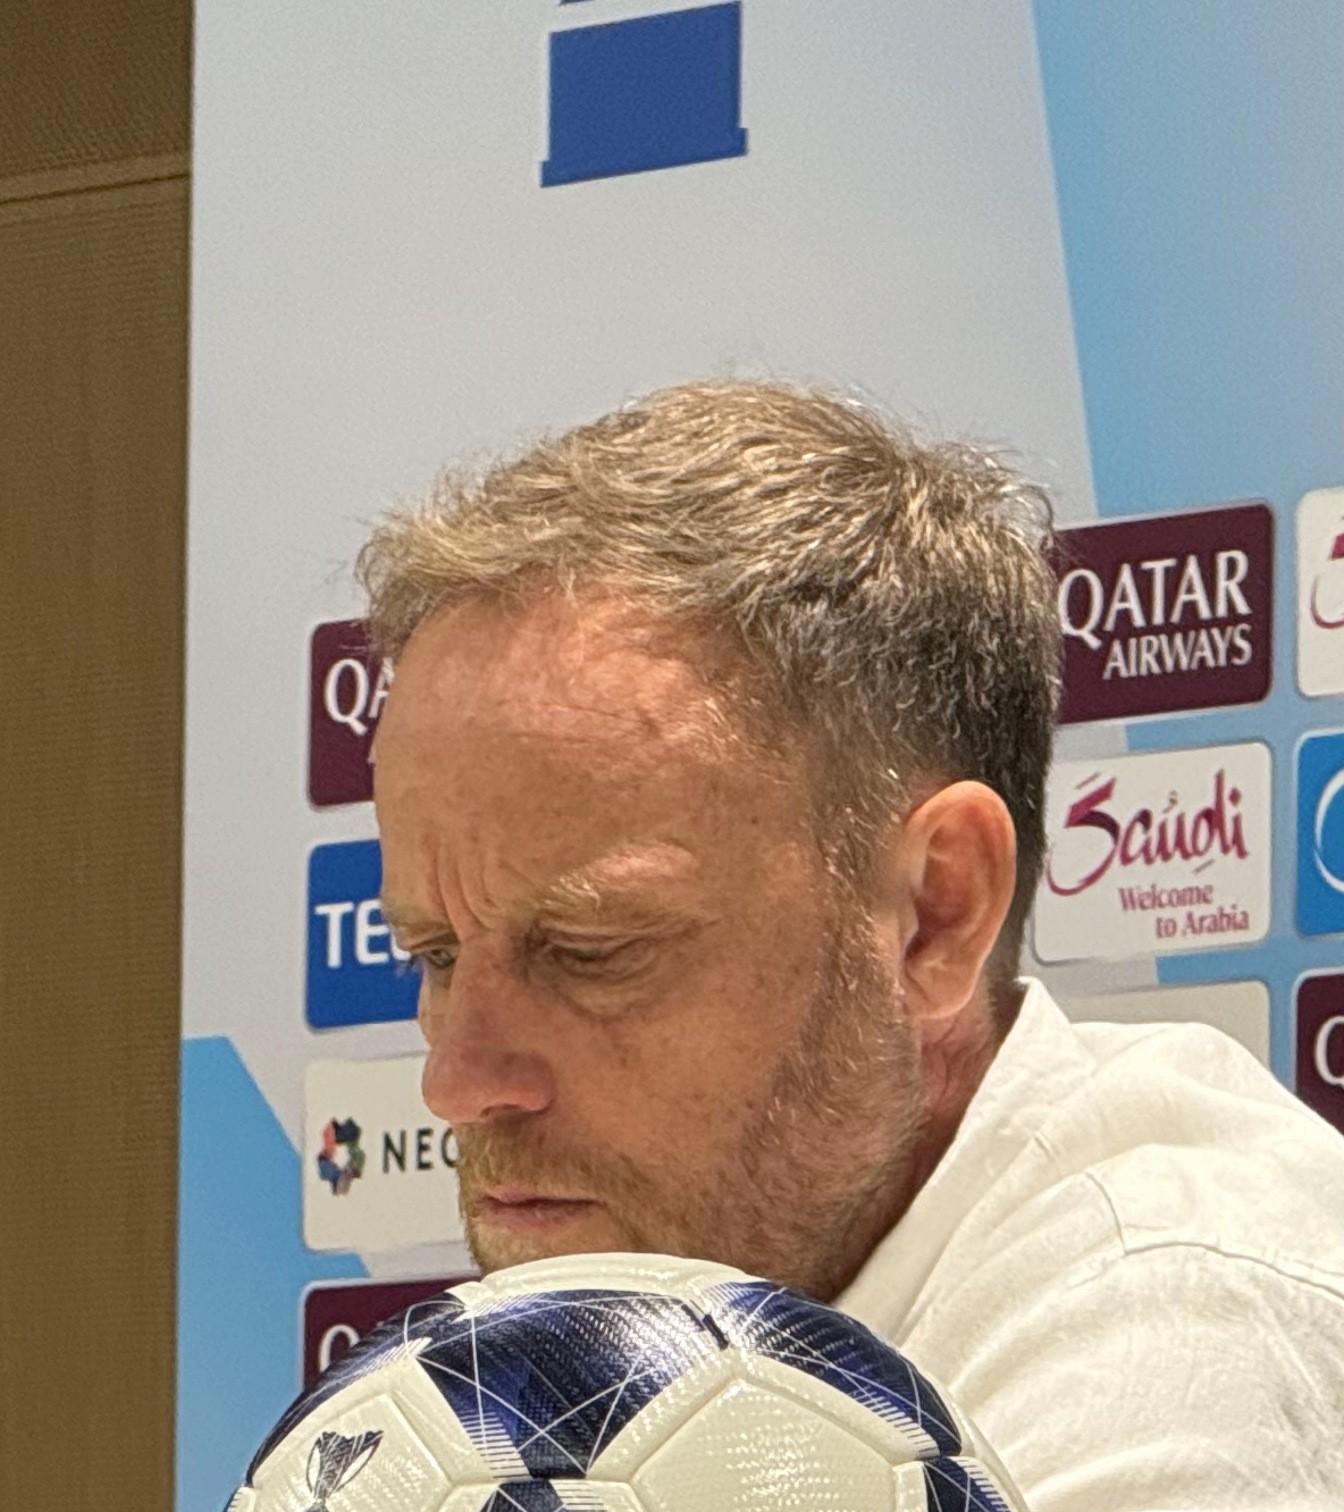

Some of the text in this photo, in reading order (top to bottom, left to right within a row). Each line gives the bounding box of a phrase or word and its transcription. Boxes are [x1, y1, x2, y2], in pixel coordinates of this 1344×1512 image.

[1061, 549, 1251, 649] QATAR
[1103, 624, 1253, 681] AIRWAYS
[1118, 884, 1214, 913] Welcome
[1156, 904, 1249, 939] to Arabia
